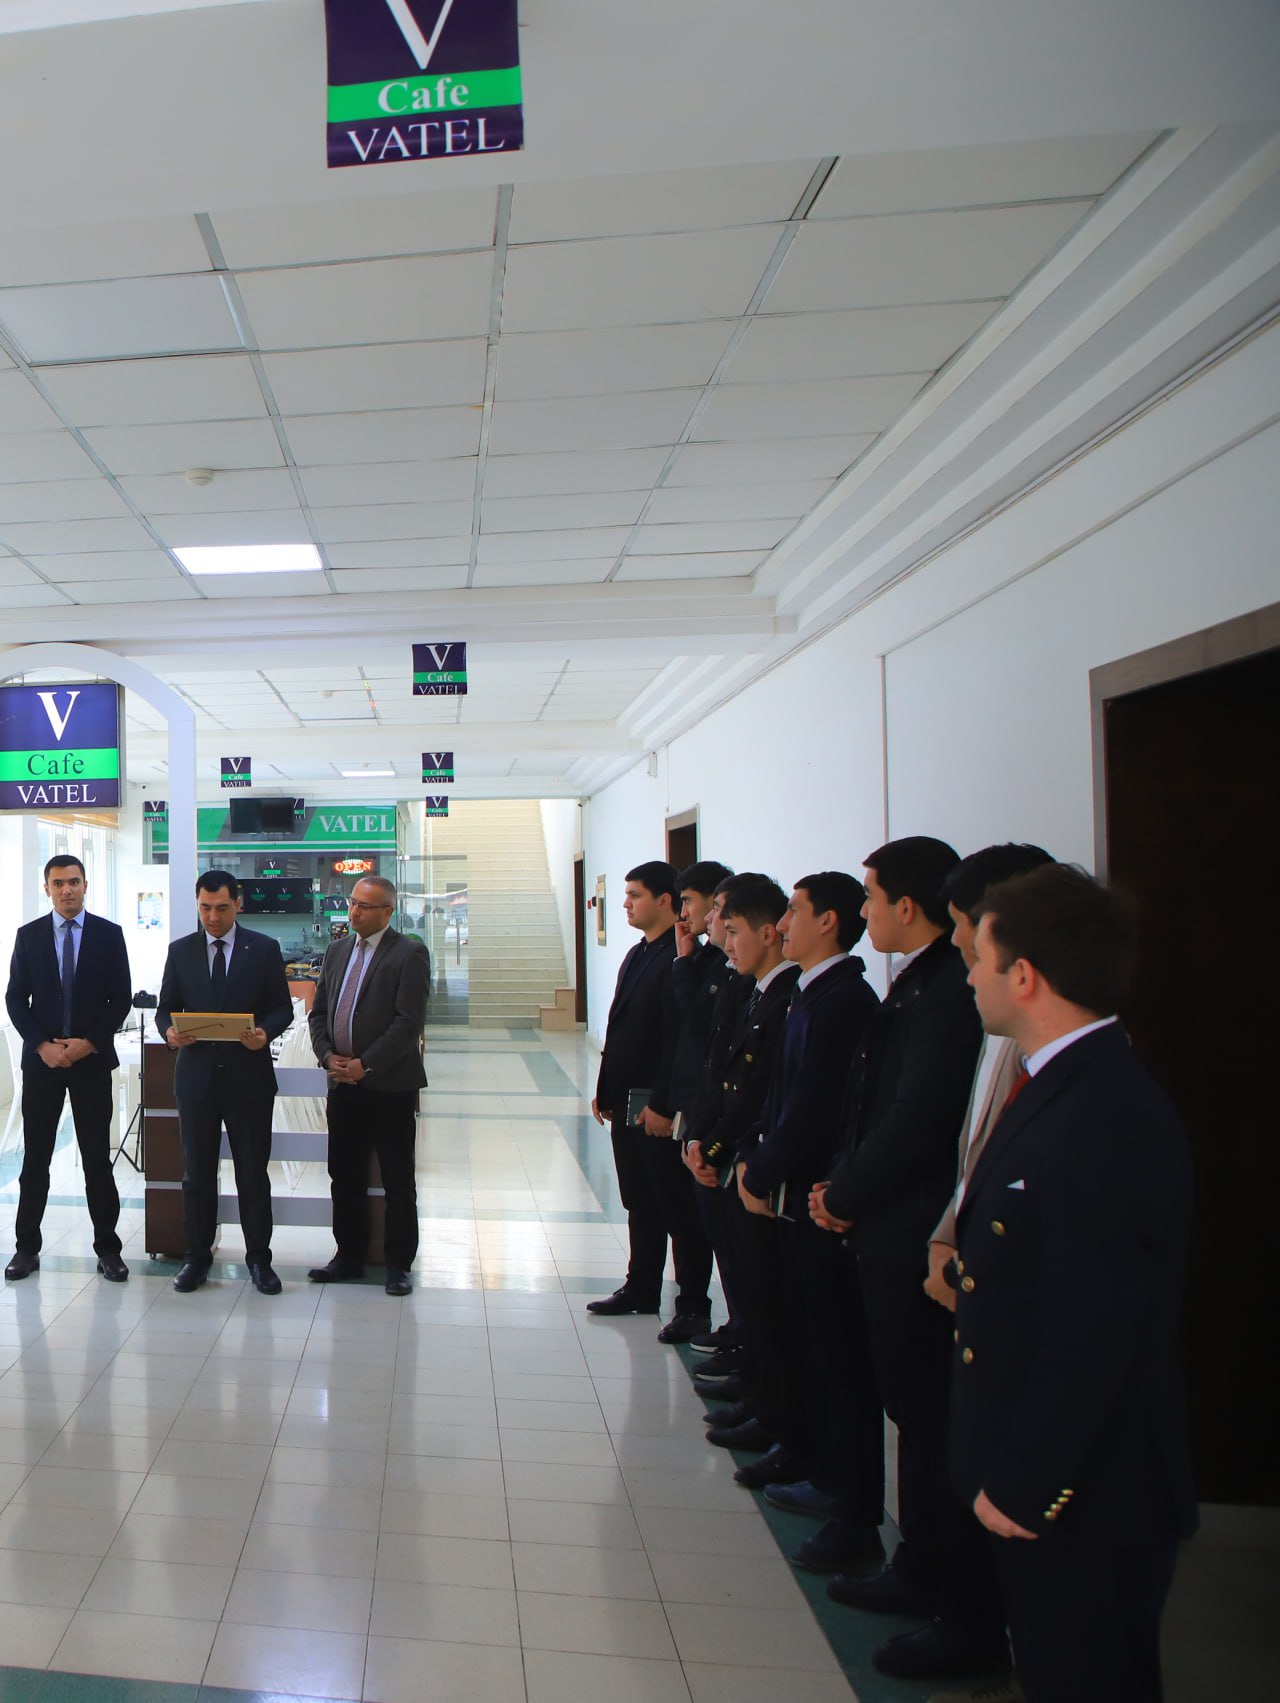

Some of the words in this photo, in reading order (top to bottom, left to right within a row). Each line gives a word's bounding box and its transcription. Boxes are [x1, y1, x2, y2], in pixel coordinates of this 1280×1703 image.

[385, 0, 454, 70] V
[378, 77, 469, 114] Cafe
[347, 117, 505, 162] VATEL
[425, 644, 454, 671] V
[427, 672, 453, 682] Cafe
[418, 684, 462, 695] VATEL
[36, 691, 81, 741] V
[27, 752, 84, 776] Cafe
[228, 758, 243, 773] V
[429, 753, 446, 769] V
[16, 784, 97, 804] VATEL
[431, 796, 443, 808] V
[319, 814, 395, 833] VATEL
[335, 861, 373, 872] OPEN
